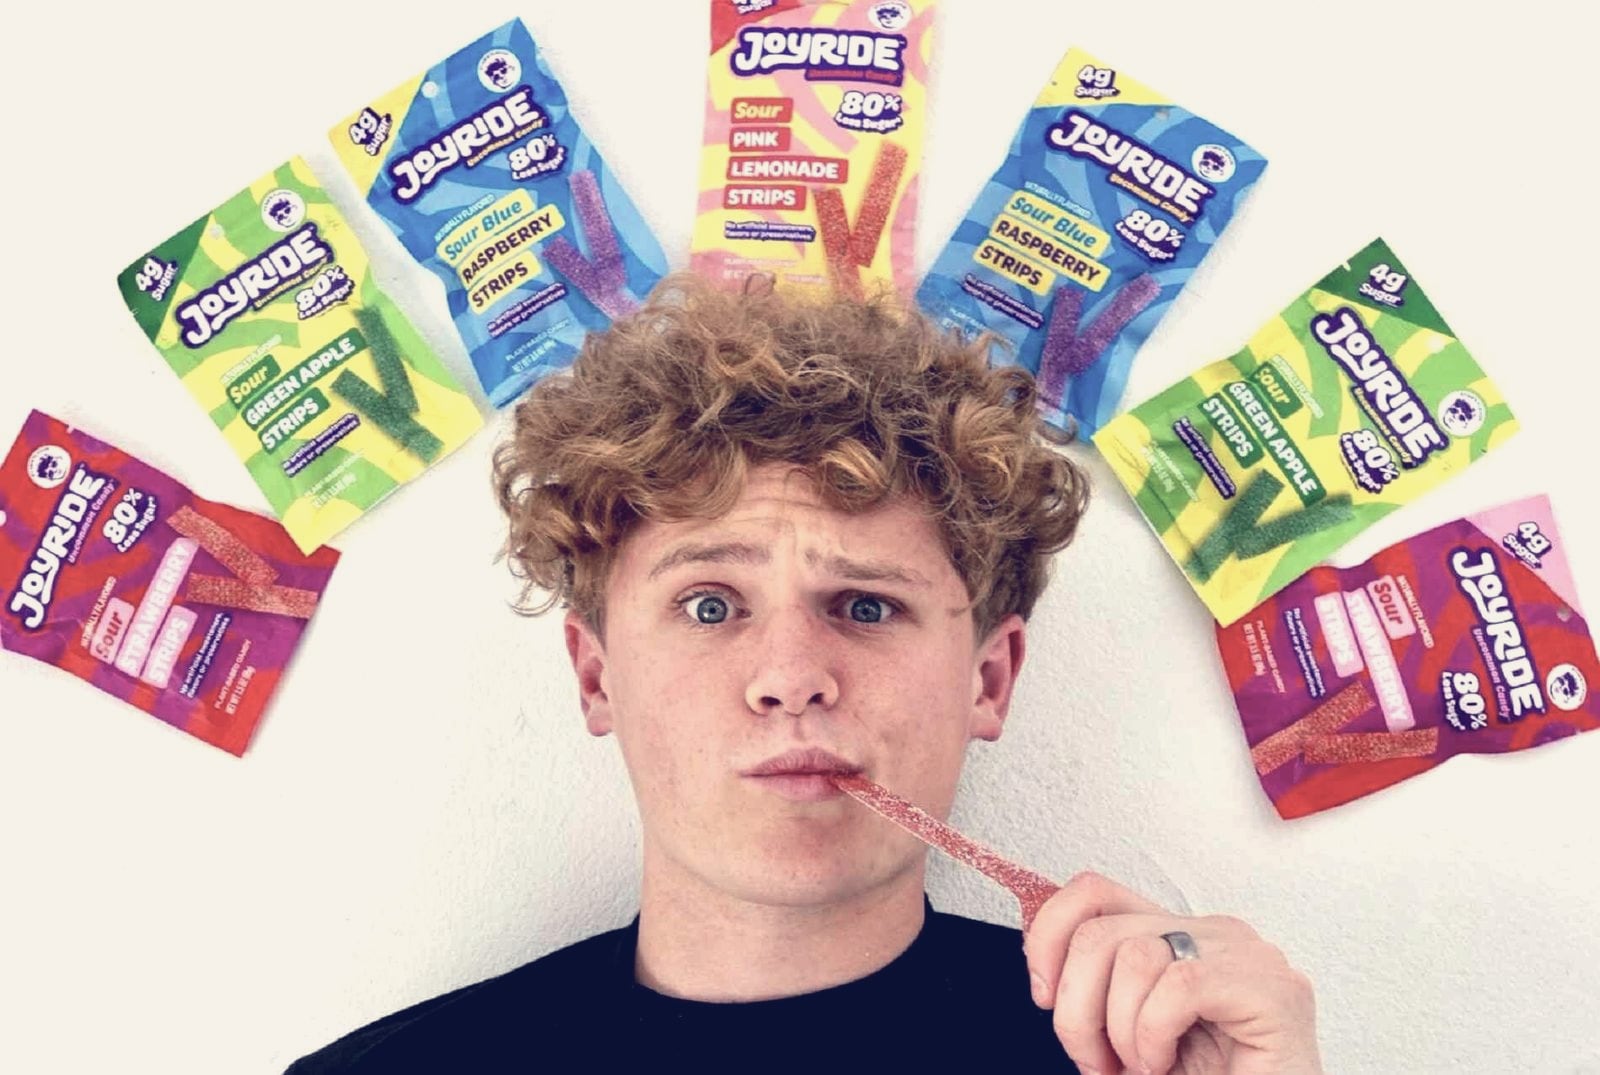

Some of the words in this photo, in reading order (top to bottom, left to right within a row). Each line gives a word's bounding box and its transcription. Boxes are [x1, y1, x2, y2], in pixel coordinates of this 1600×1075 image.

[736, 32, 897, 69] JOYRIDE
[1078, 65, 1111, 87] 4g
[350, 109, 377, 143] 4g
[734, 102, 783, 118] Sour
[842, 90, 900, 118] 80%
[365, 116, 390, 155] Sugar
[395, 93, 537, 197] JOYRIDE
[507, 131, 556, 172] 80%
[733, 131, 779, 146] PINK
[731, 161, 839, 178] LEMONADE
[1052, 116, 1206, 210] JOYRIDE
[727, 189, 796, 205] STRIPS
[443, 225, 481, 260] Sour
[478, 198, 523, 232] Blue
[1010, 194, 1054, 226] Sour
[1052, 215, 1098, 249] Blue
[1124, 208, 1185, 248] 80%
[462, 212, 550, 283] RASPBERRY
[979, 243, 1043, 286] STRIPS
[995, 218, 1101, 283] RASPBERRY
[136, 258, 162, 290] 4g
[152, 264, 176, 301] Sugar
[182, 231, 323, 342] JOYRIDE
[294, 266, 344, 312] 80%
[470, 260, 529, 308] STRIPS
[1359, 282, 1401, 303] Sugar
[1370, 264, 1405, 291] 4g
[227, 364, 271, 404] Sour
[247, 376, 299, 423] GREEN
[300, 338, 354, 382] APPLE
[1253, 366, 1290, 408] Sour
[1317, 313, 1439, 456] JOYRIDE
[262, 398, 317, 447] STRIPS
[1203, 398, 1252, 455] STRIPS
[1230, 379, 1277, 437] GREEN
[1269, 439, 1316, 494] APPLE
[1351, 427, 1399, 482] 80%
[67, 509, 96, 563] Uncommon
[91, 481, 116, 511] Candy
[100, 487, 142, 544] 80%
[1519, 522, 1549, 553] 4g
[12, 470, 103, 626] JOYRIDE
[116, 529, 140, 552] Less
[1503, 534, 1538, 564] Sugar
[119, 544, 190, 672] STRAWBERRY
[1372, 581, 1403, 626] Sour
[94, 611, 125, 658] Sour
[146, 615, 187, 684] STRIPS
[1317, 597, 1355, 665] STRIPS
[1454, 553, 1541, 713] JOYRIDE
[1345, 594, 1408, 723] STRAWBERRY
[1472, 627, 1501, 683] Uncommon
[1494, 683, 1510, 719] Candy
[1442, 671, 1452, 700] Less
[1453, 671, 1487, 729] 80%
